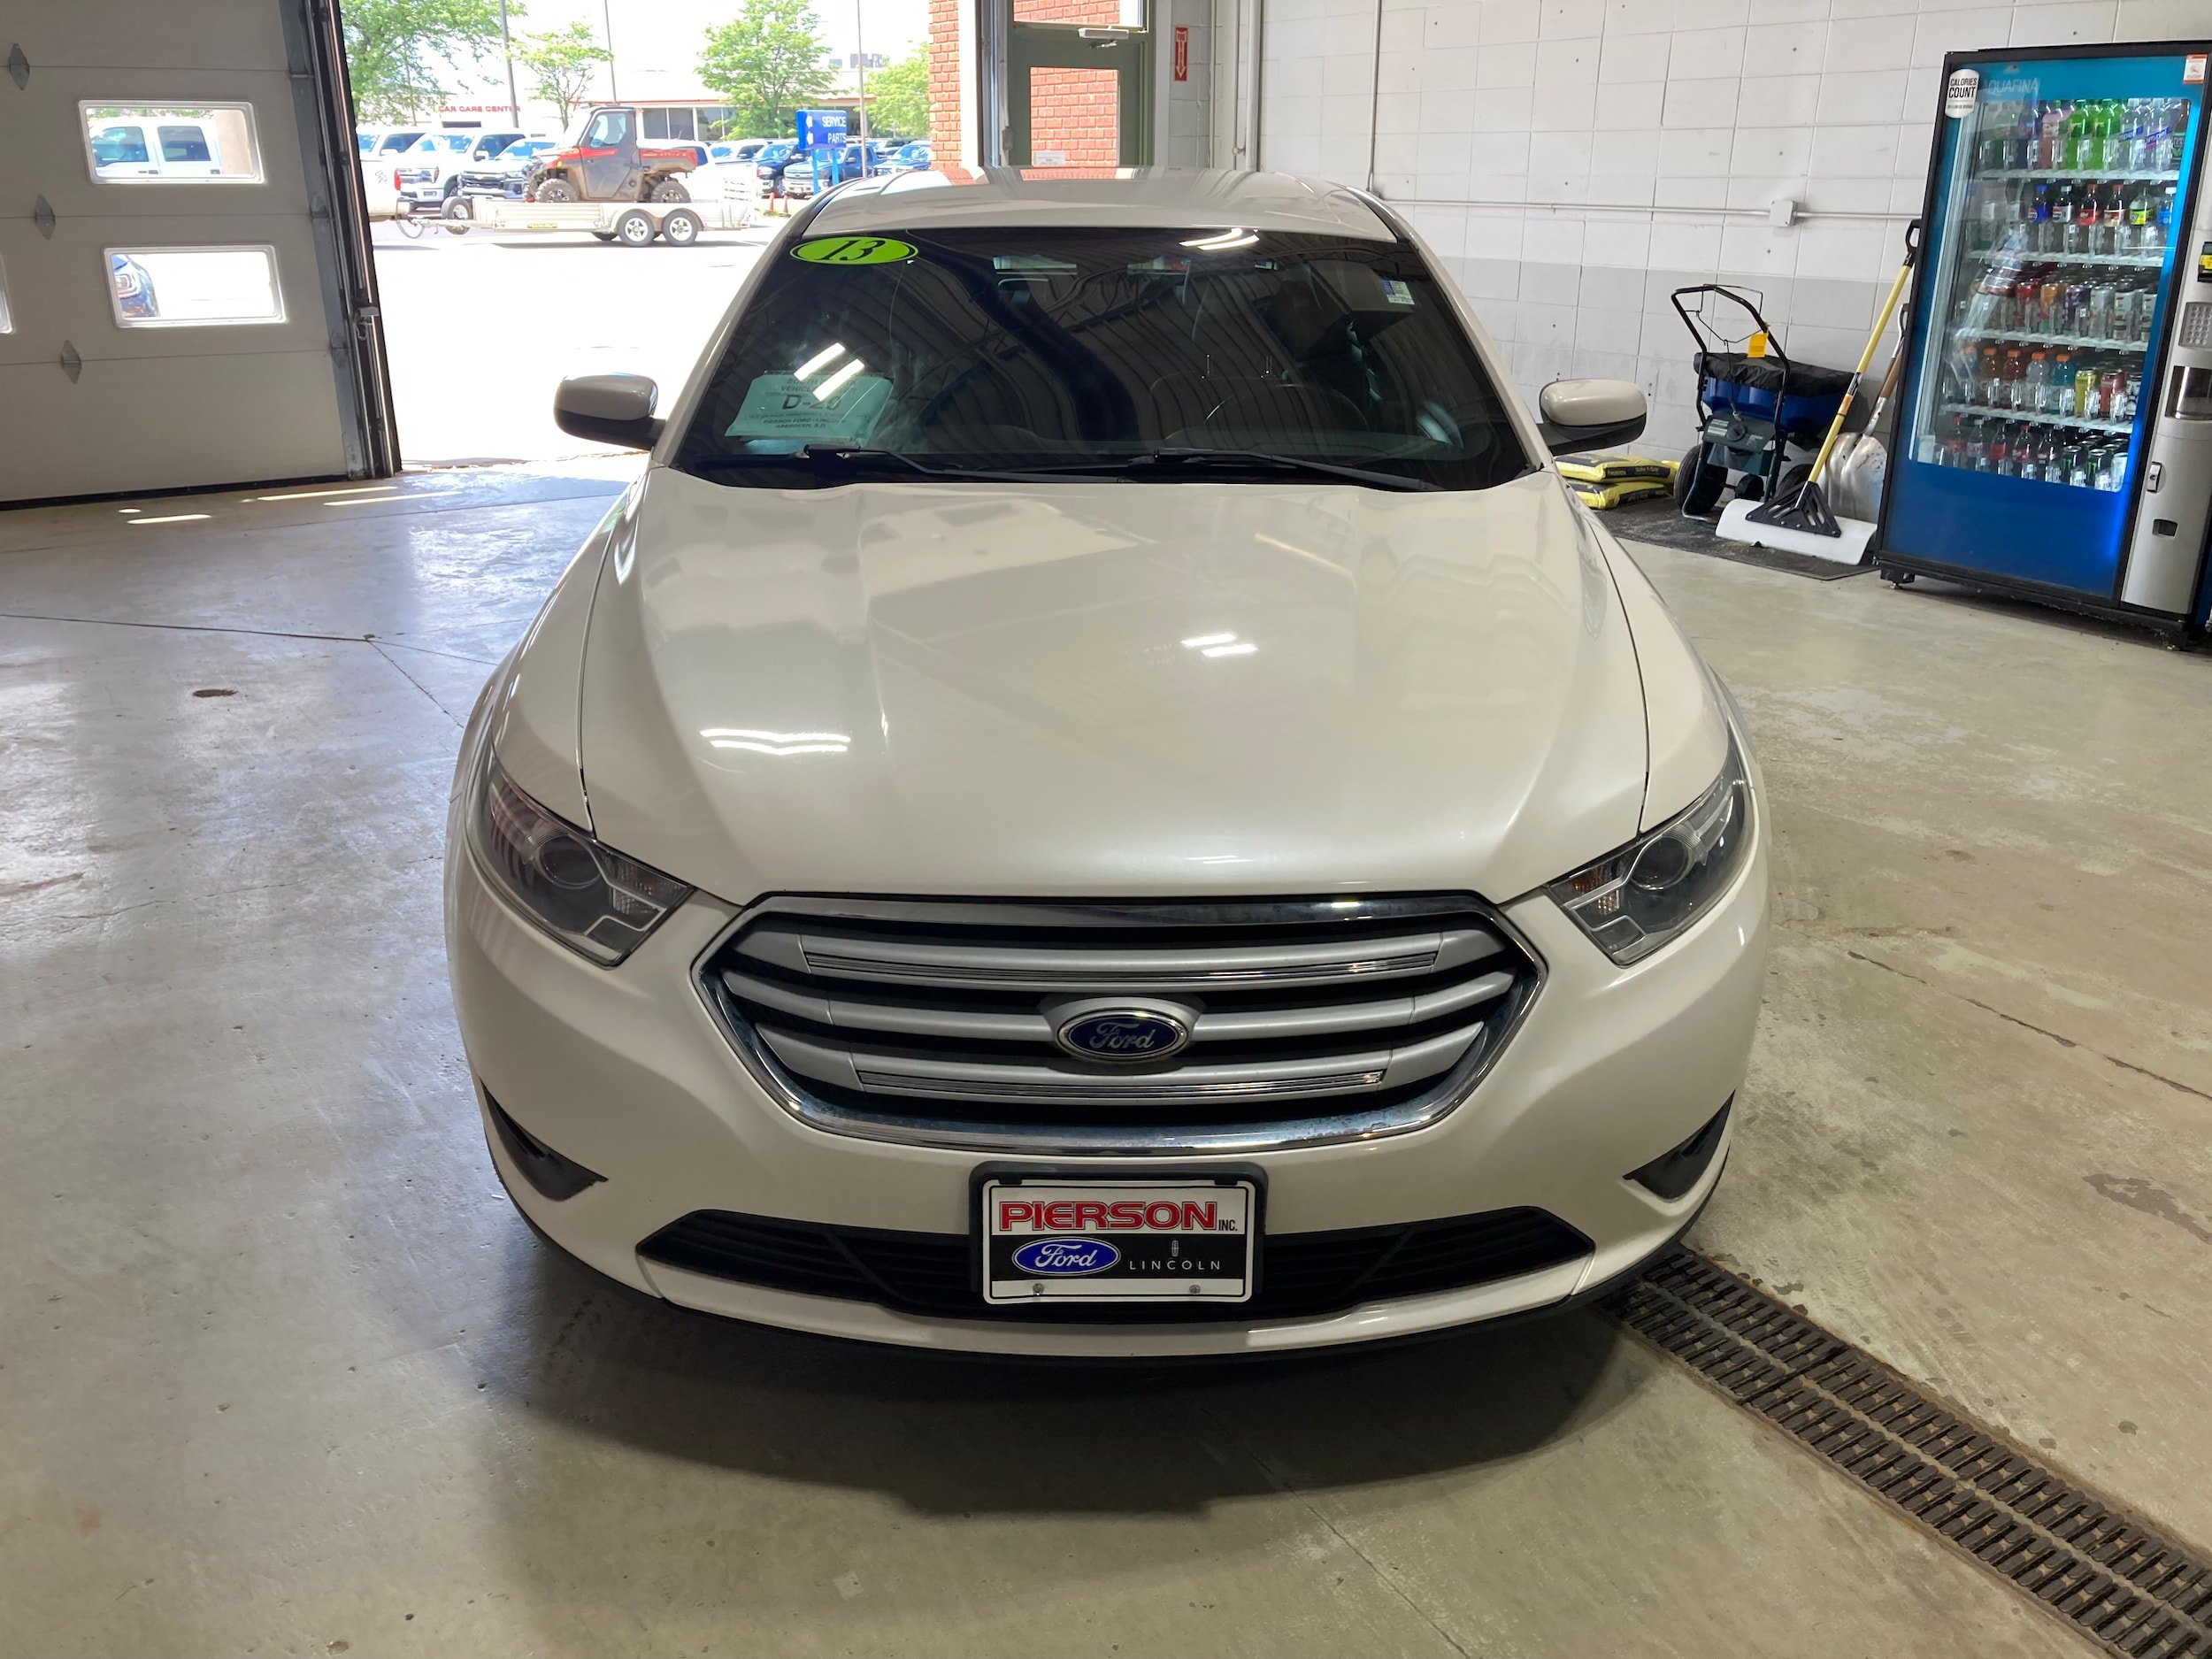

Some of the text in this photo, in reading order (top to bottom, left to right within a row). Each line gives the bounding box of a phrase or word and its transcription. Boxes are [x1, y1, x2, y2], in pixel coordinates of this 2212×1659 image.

[1950, 77, 1977, 87] CALORIES
[1983, 78, 2038, 96] AQUAFINA
[1948, 87, 1976, 98] COUNT
[822, 116, 847, 127] SERVICE
[827, 133, 847, 143] PARTS
[814, 239, 886, 261] 13
[1089, 1021, 1156, 1049] Ford
[999, 1201, 1239, 1232] PIERSON INC.
[1034, 1244, 1221, 1271] Ford LINCOLN
